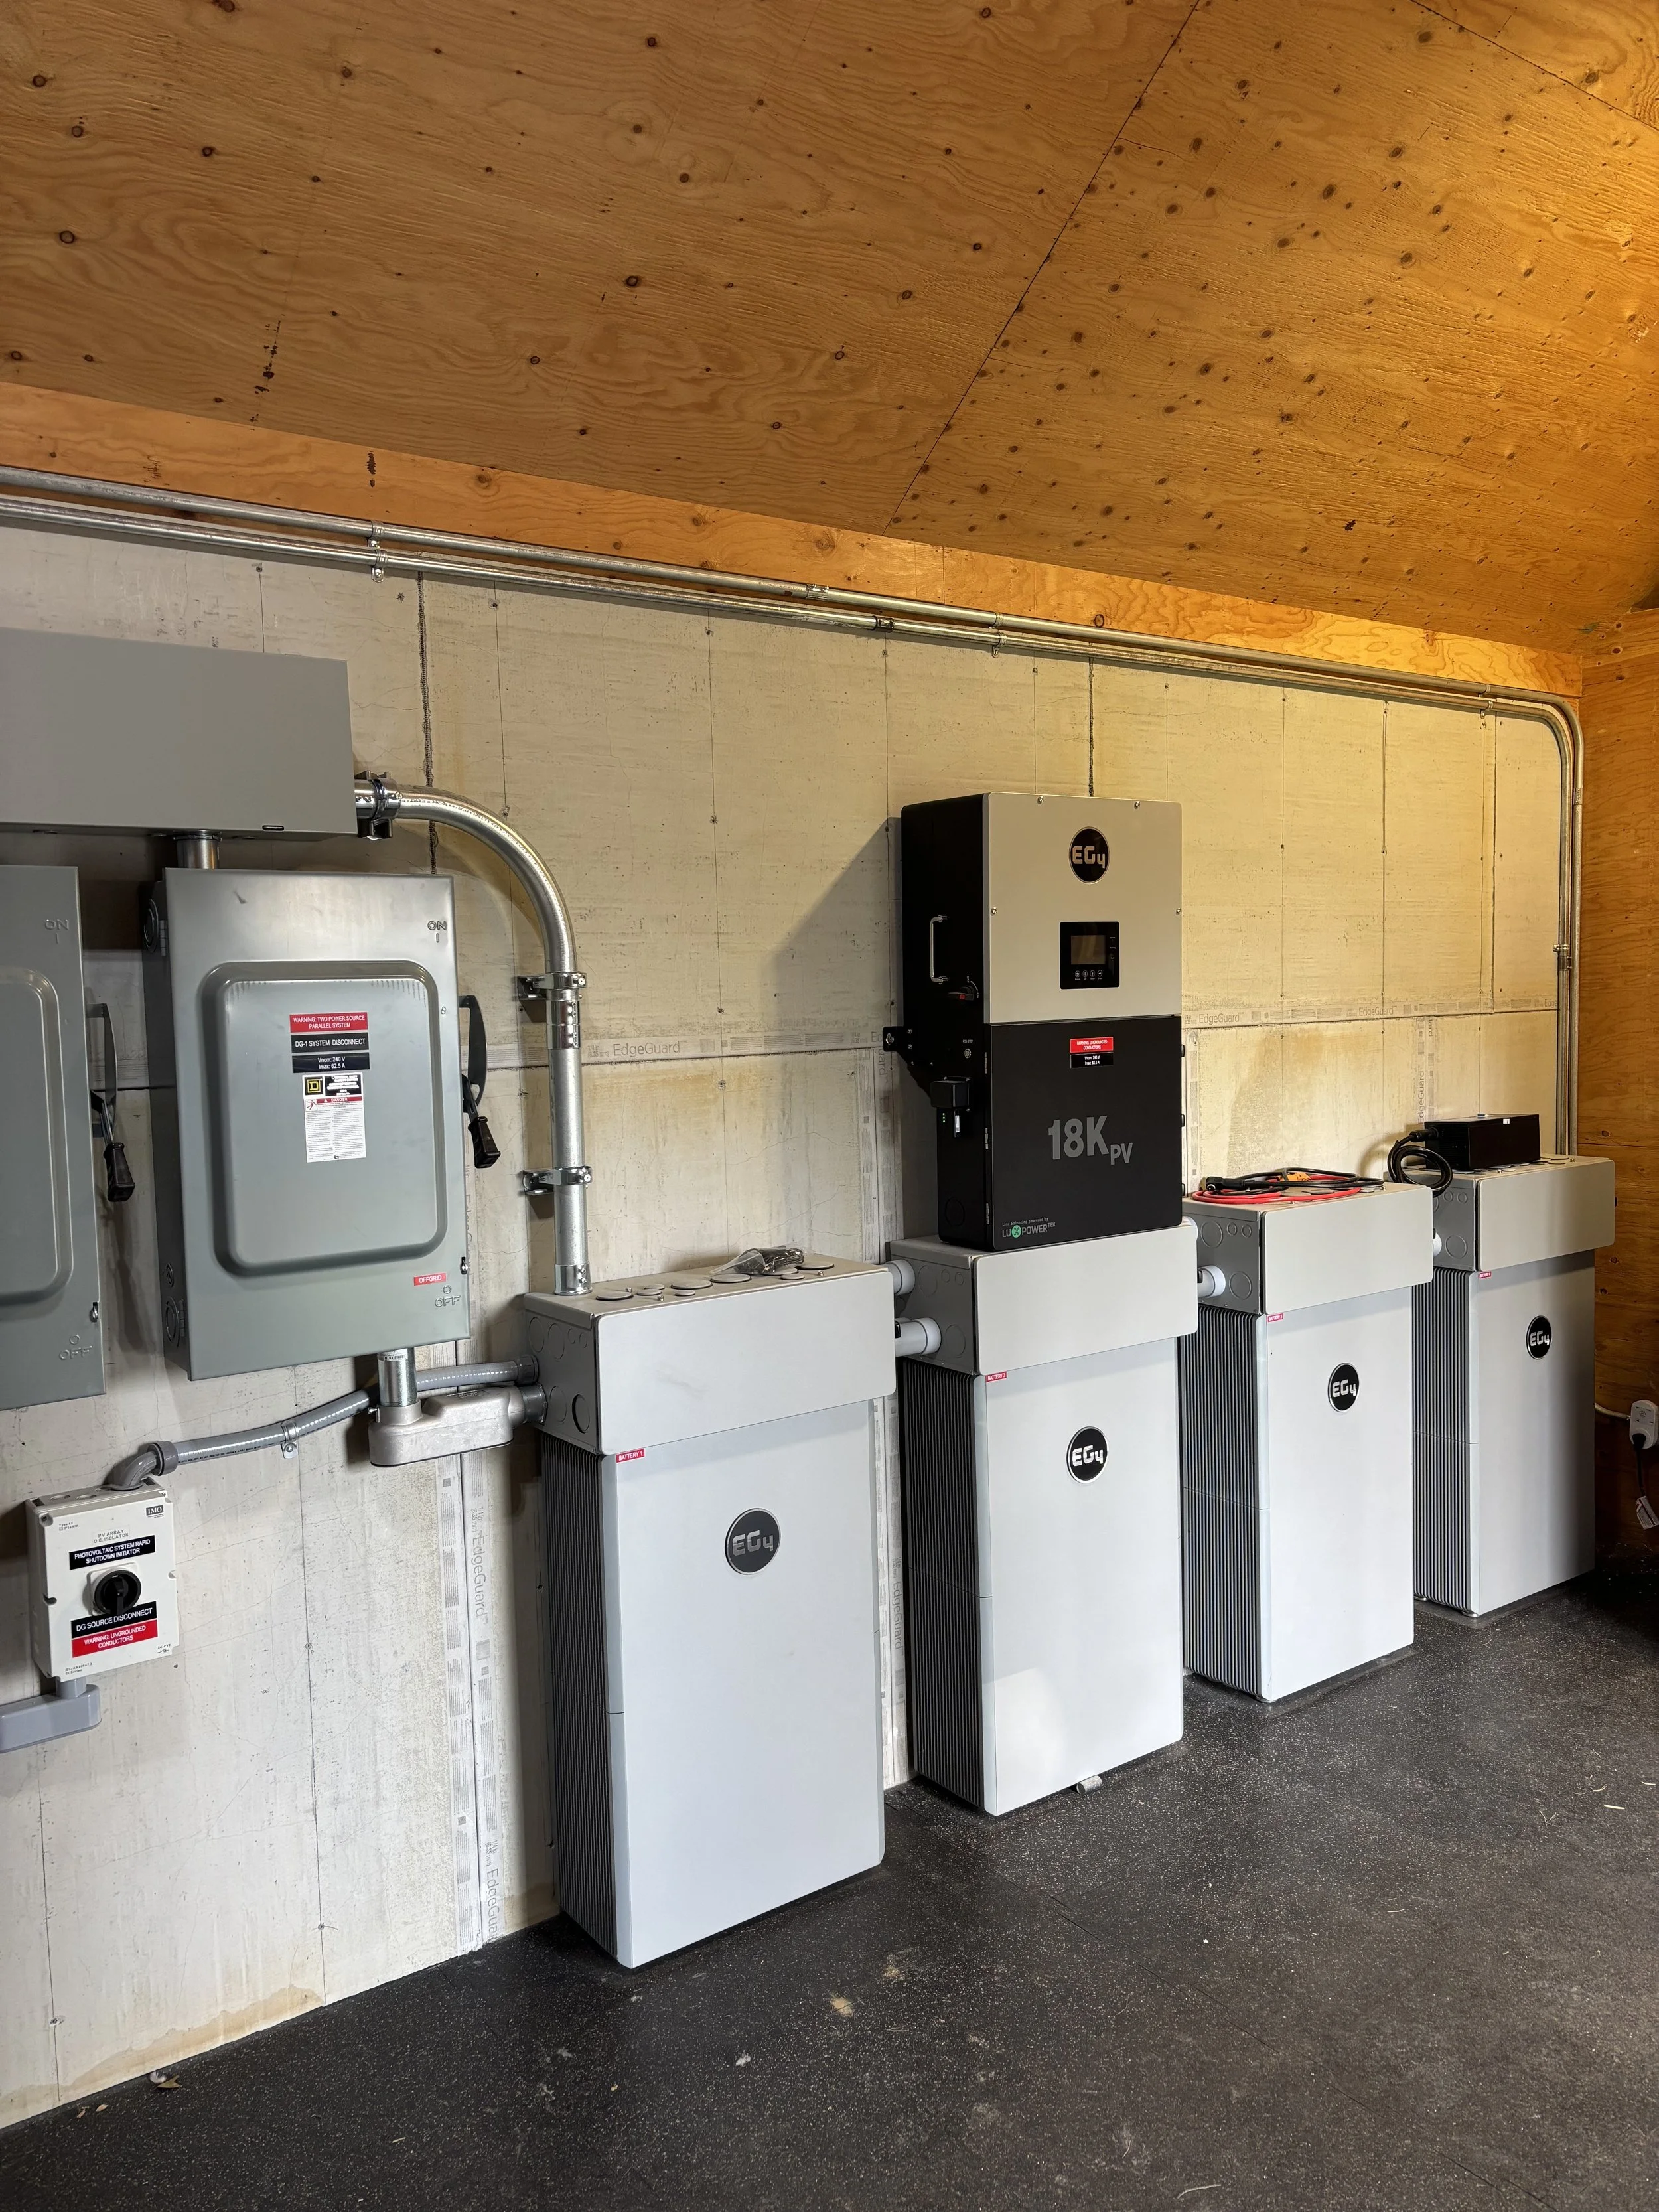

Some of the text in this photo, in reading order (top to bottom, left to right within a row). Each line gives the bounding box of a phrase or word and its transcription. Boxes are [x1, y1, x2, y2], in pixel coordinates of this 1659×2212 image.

[45, 919, 69, 930] ON
[427, 921, 447, 930] ON
[1199, 1013, 1240, 1025] EdgeGuard
[1358, 1006, 1394, 1017] EdgeGuard
[613, 1041, 680, 1057] EdgeGuard
[419, 1274, 442, 1283] OFFGRID
[435, 1295, 461, 1307] OFF
[1530, 1330, 1550, 1346] EG4
[59, 1346, 92, 1360] OFF
[1332, 1379, 1356, 1398] EG4
[618, 1451, 639, 1461] BATTERY
[1072, 1445, 1103, 1467] EG4
[104, 1532, 129, 1541] ISOLATOR
[732, 1530, 774, 1556] EG4
[74, 1546, 113, 1560] PHOTOVOLTAIC
[114, 1542, 135, 1552] SYSTEM
[86, 1548, 141, 1564] SHUTDOWN INITIATOR
[471, 1536, 488, 1617] EdgeGuard
[76, 1607, 153, 1632] DG SOURCE DISCONNECT
[892, 1581, 904, 1650] EdgeGuard
[84, 1625, 147, 1645] WARNING: UNGROUNDED
[98, 1636, 133, 1649] CONDUCTORS
